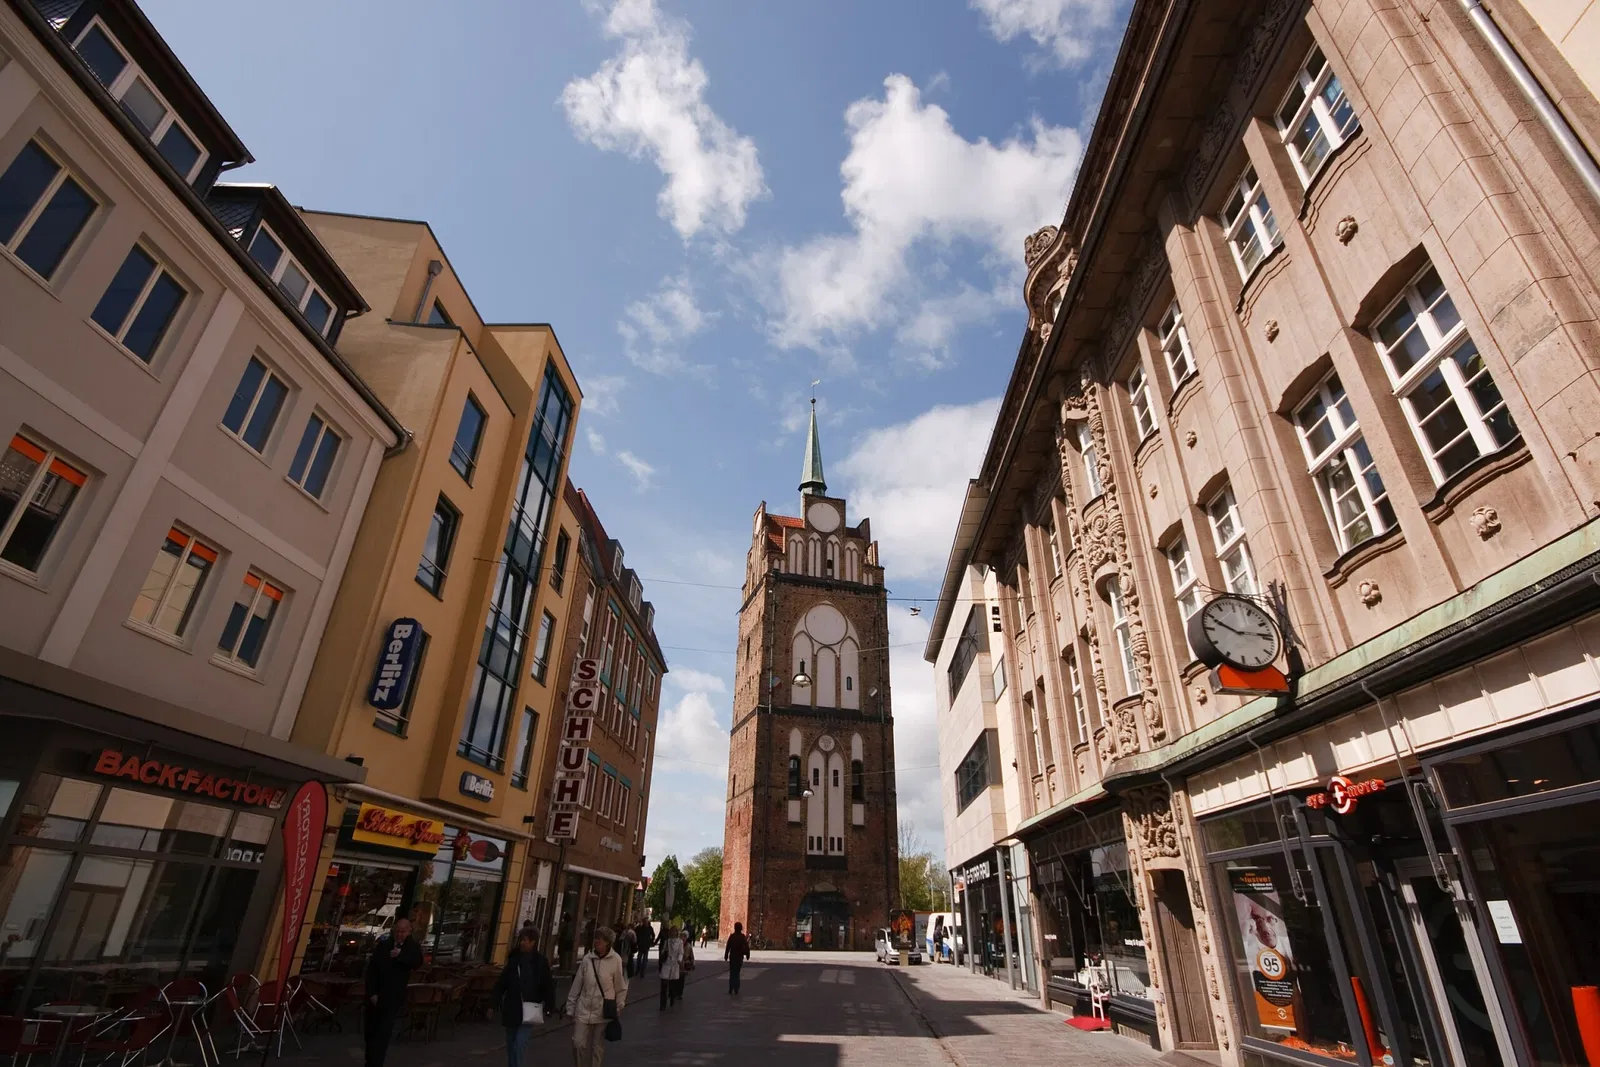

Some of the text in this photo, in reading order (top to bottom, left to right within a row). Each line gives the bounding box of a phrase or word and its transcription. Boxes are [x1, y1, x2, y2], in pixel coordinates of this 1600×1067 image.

[373, 624, 414, 702] Berlitz
[552, 660, 596, 836] SCHUHE
[466, 775, 496, 799] Berlitz
[1346, 778, 1380, 798] more
[1263, 957, 1280, 973] 95
